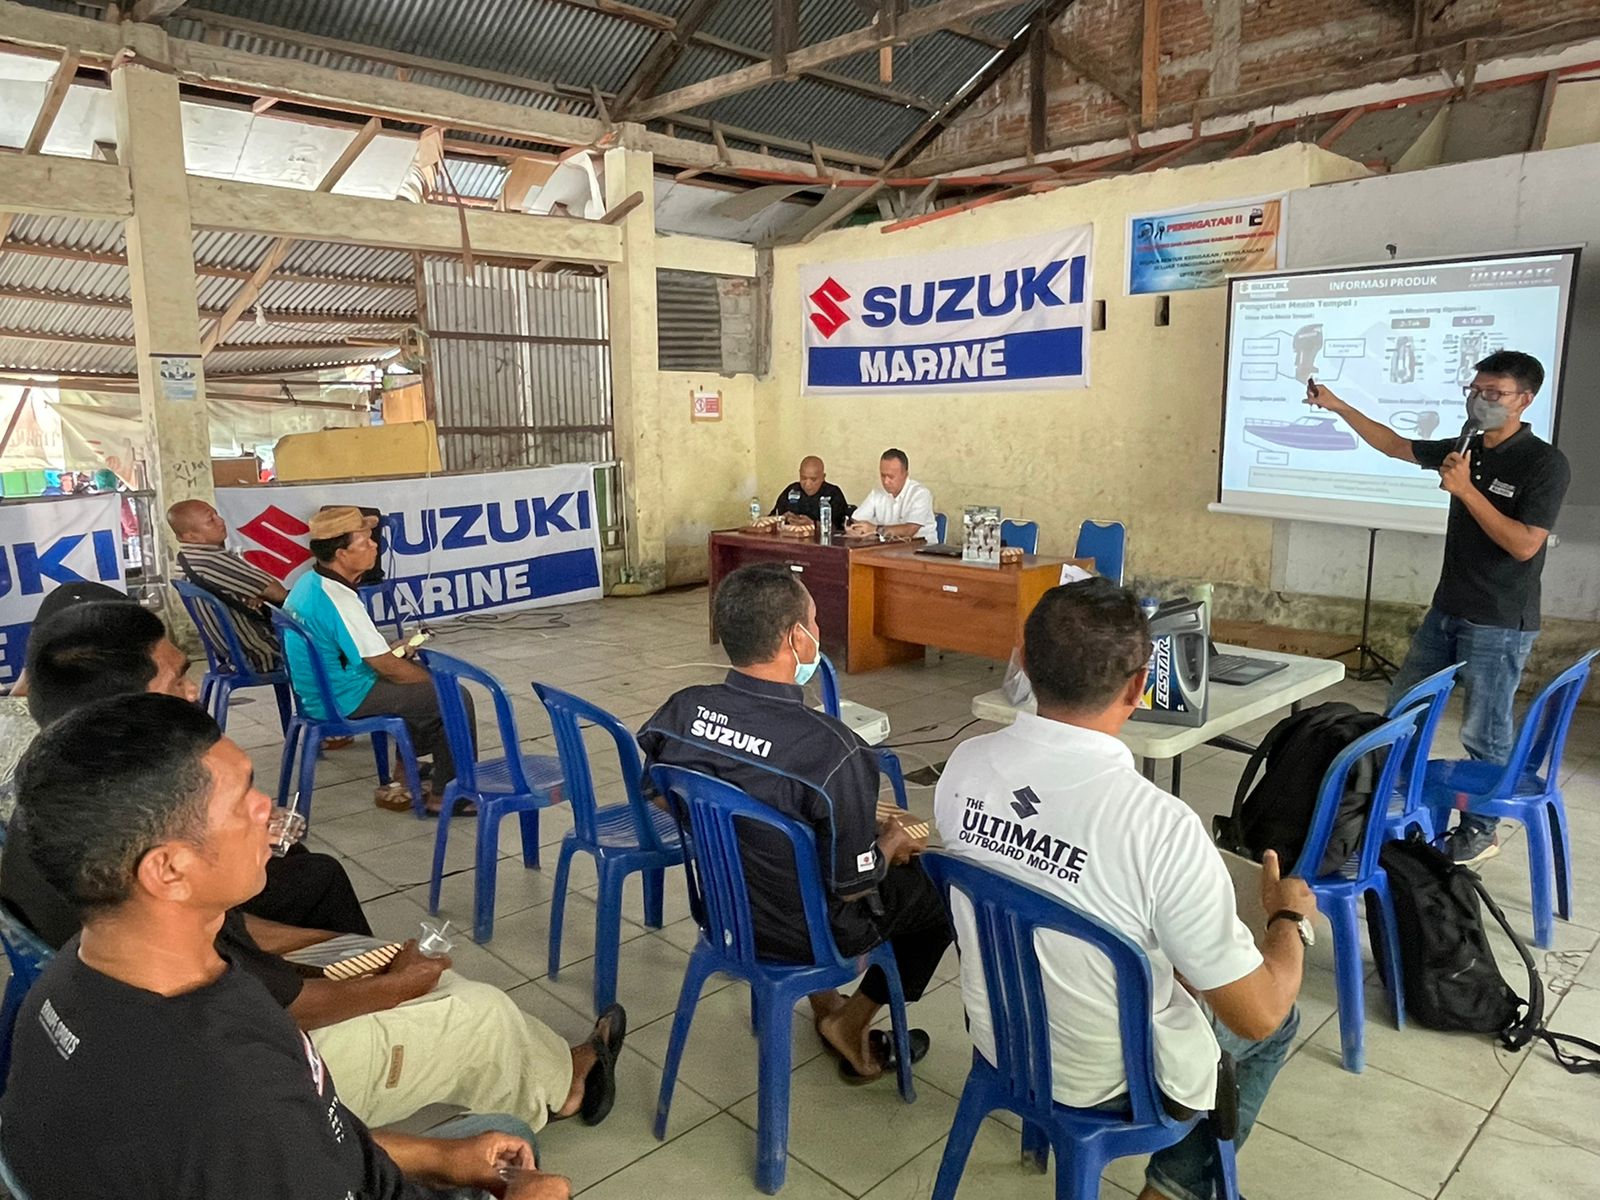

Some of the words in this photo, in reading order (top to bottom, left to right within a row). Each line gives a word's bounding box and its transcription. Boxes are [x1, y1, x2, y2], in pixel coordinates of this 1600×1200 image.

[1167, 216, 1233, 233] PERINGATAN
[861, 255, 1086, 328] SUZUKI
[1329, 279, 1388, 291] INFORMASI
[1390, 275, 1438, 287] PRODUK
[859, 340, 1006, 383] MARINE
[381, 490, 591, 556] UZUKI
[1157, 636, 1170, 709] ECSTAR
[697, 706, 728, 726] Team
[691, 720, 772, 758] SUZUKI
[967, 797, 985, 811] THE
[959, 830, 1024, 861] OUTBOARD
[1026, 854, 1080, 884] MOTOR
[963, 809, 1088, 872] ULTIMATE
